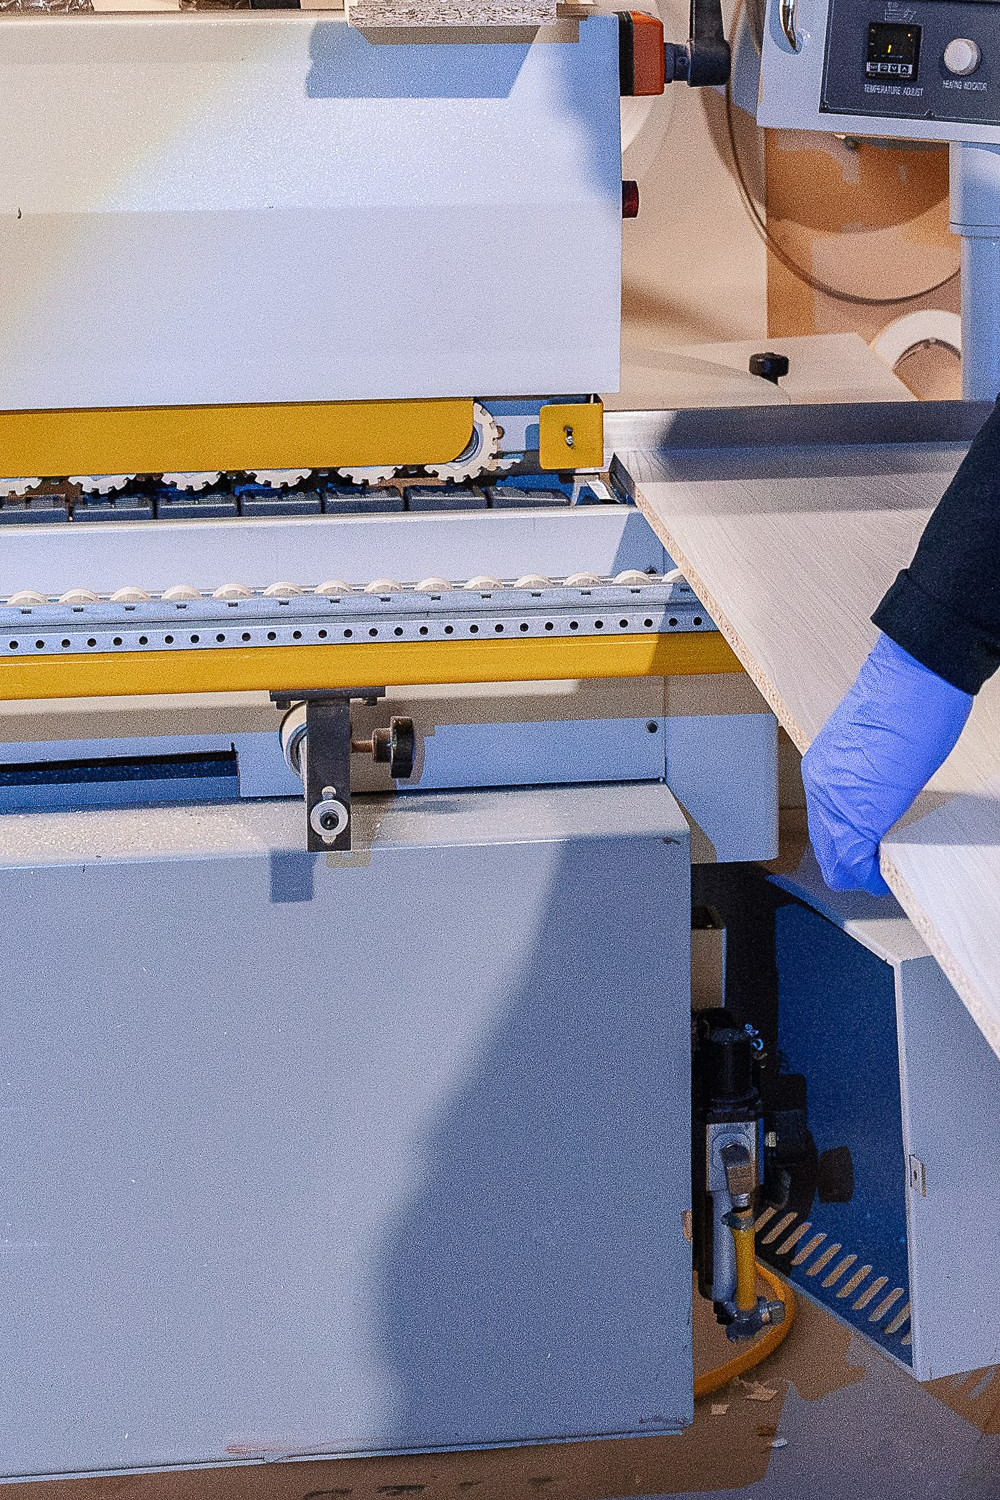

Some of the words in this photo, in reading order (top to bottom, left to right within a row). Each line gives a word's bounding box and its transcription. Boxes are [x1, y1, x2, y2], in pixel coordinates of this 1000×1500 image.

[864, 83, 901, 96] TEMPERATURE
[902, 86, 924, 97] ADJUST
[942, 79, 962, 90] HEATING
